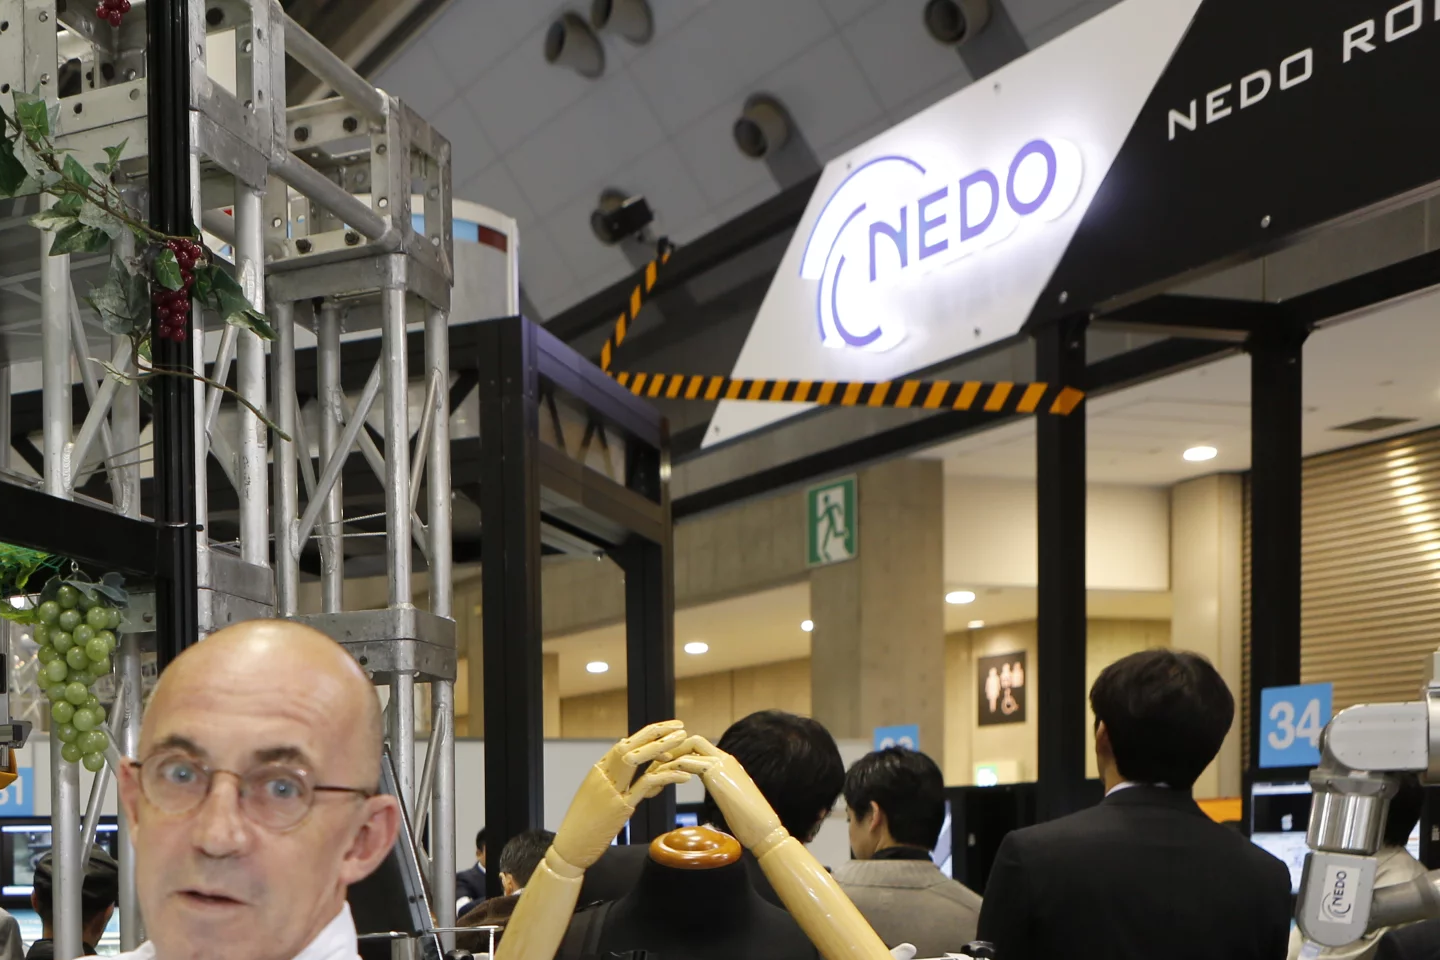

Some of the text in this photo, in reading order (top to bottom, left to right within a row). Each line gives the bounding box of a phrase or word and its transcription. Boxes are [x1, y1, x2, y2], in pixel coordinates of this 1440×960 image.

[1168, 0, 1440, 142] NEDO RO
[867, 138, 1058, 284] NEDO
[1267, 697, 1322, 751] 34
[1331, 869, 1348, 907] NEDO
